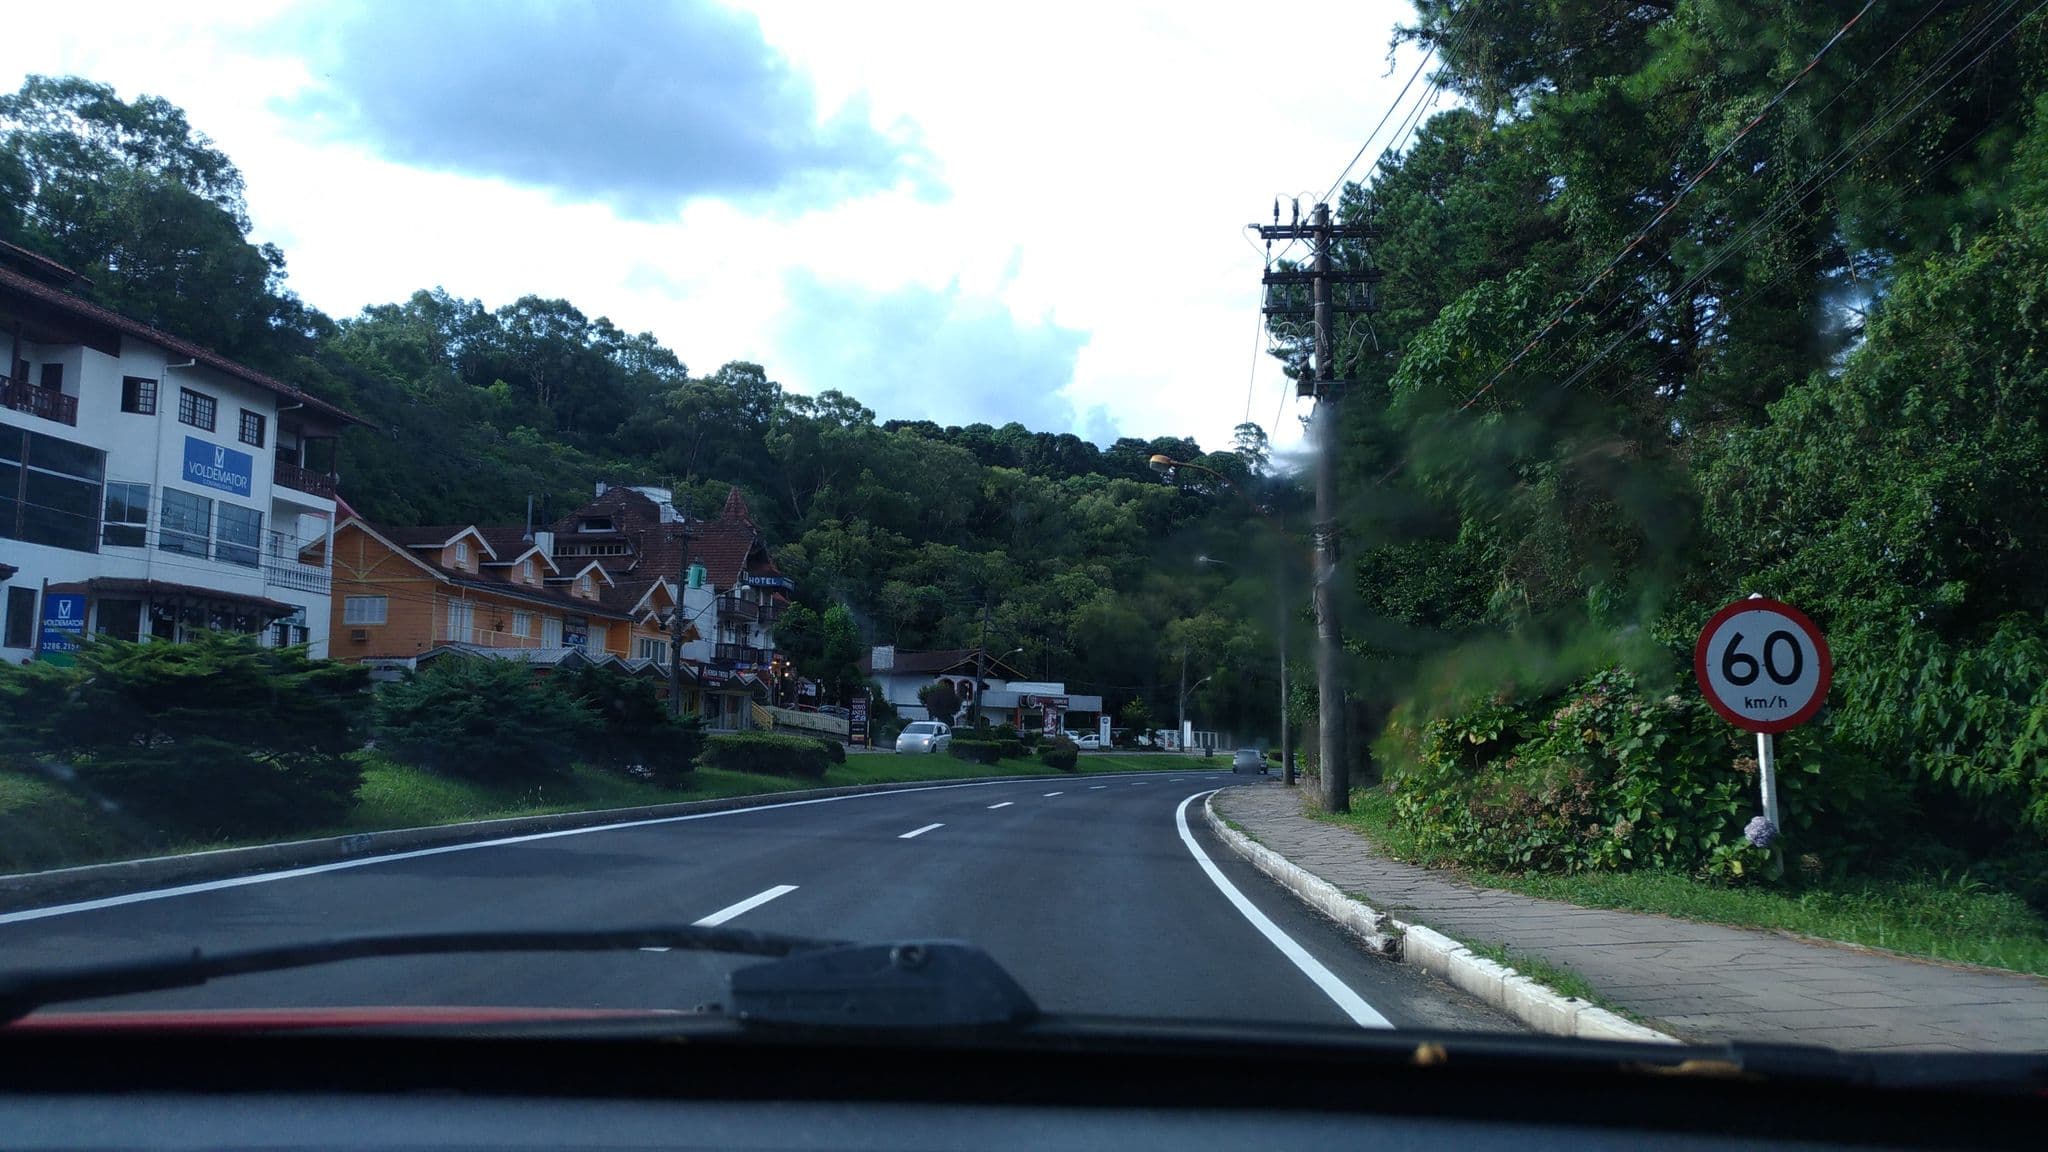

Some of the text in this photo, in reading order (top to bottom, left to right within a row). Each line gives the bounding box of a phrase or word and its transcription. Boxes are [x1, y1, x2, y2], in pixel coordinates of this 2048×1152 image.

[189, 461, 248, 489] VOLDEMATOR
[748, 576, 777, 585] HOTEL
[1722, 630, 1803, 687] 60
[1745, 695, 1788, 709] km/h
